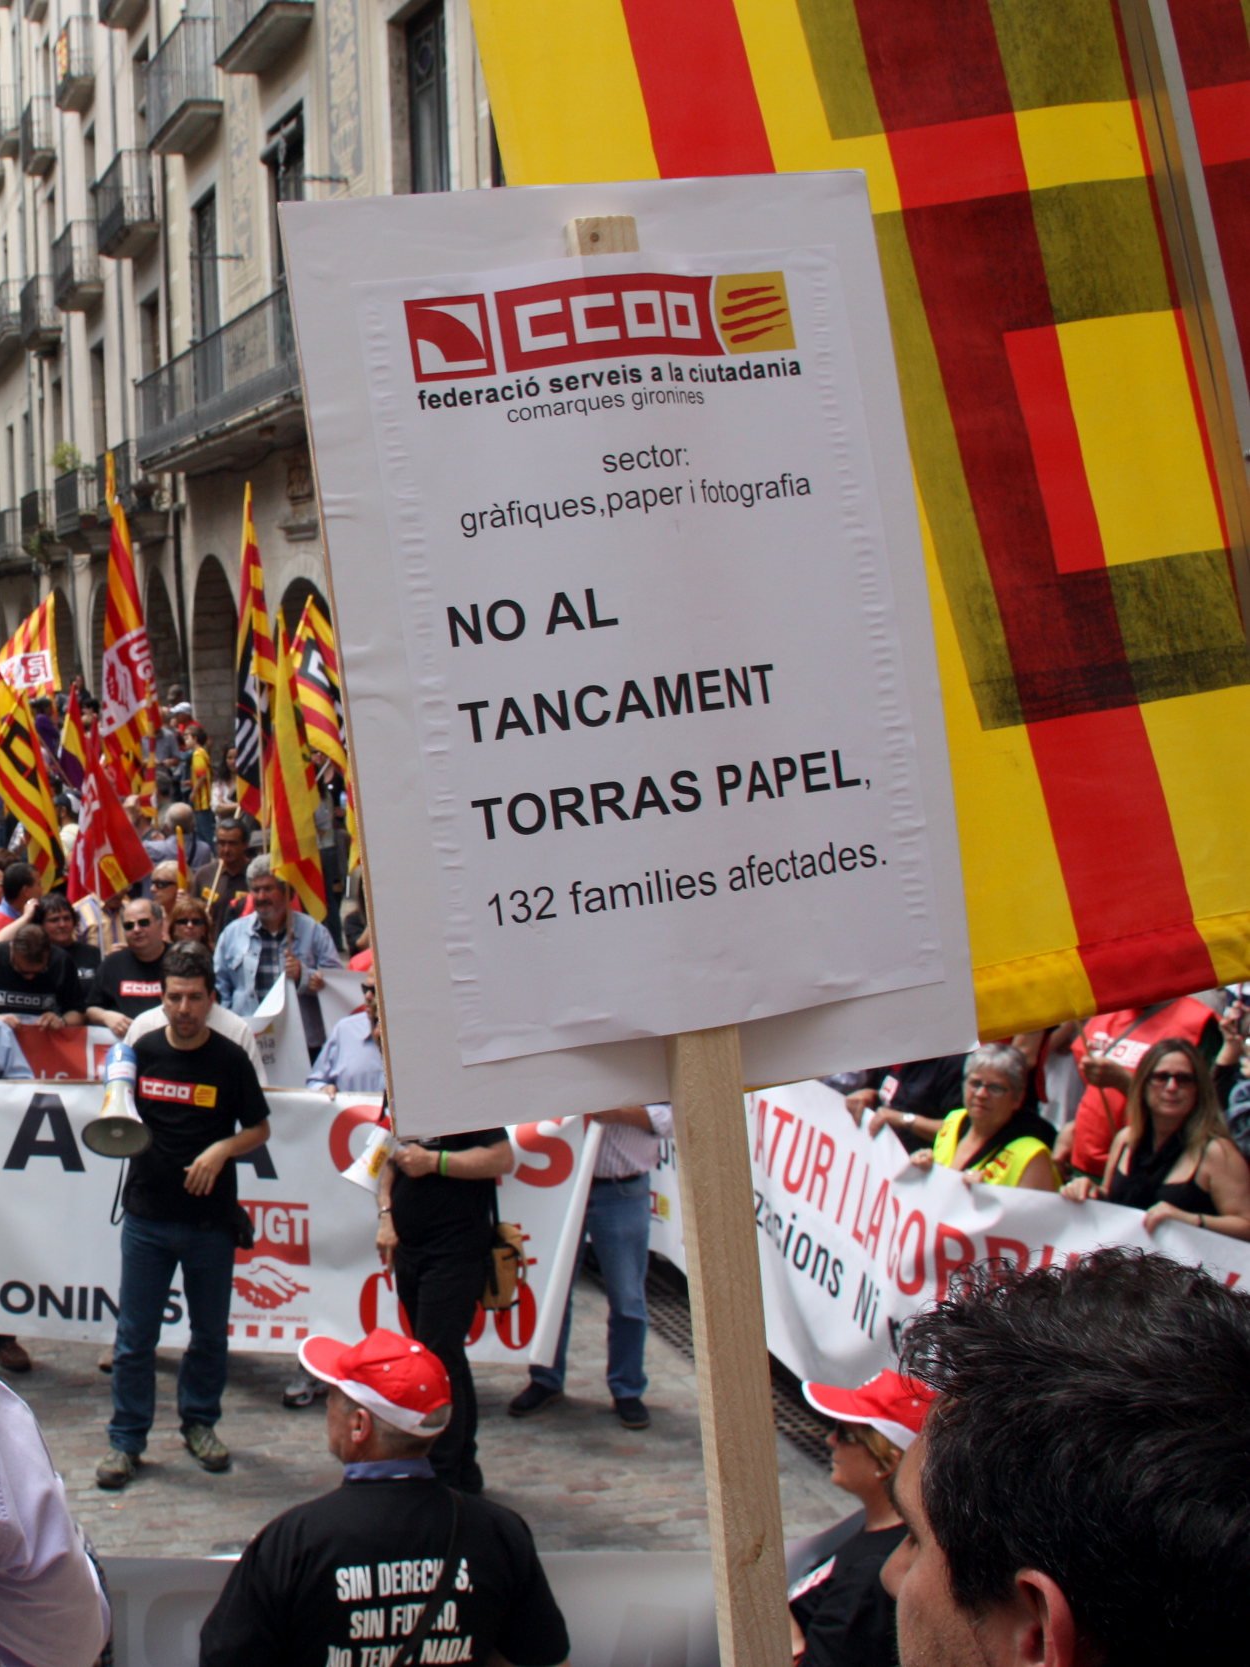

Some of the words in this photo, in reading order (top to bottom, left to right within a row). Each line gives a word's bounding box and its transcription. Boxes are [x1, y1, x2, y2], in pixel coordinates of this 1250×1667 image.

[514, 289, 701, 353] CCOO
[418, 377, 540, 411] federació
[549, 364, 643, 395] serveis
[650, 366, 663, 382] a
[668, 360, 684, 382] la
[688, 357, 802, 384] ciutadania
[507, 391, 625, 424] comarques
[631, 388, 705, 411] gironines
[601, 444, 691, 473] sector:
[689, 480, 696, 504] i
[700, 473, 812, 509] fotografia
[446, 599, 526, 648] NO
[545, 587, 619, 635] AL
[458, 663, 774, 743] TANCAMENT
[471, 769, 702, 841] TORRAS
[715, 749, 872, 807] PAPEL,
[487, 885, 557, 927] 132
[569, 863, 717, 915] families
[727, 841, 888, 892] afectades.
[141, 1079, 190, 1100] CCOO
[3, 1093, 86, 1173] A
[335, 1565, 372, 1602] SIN
[378, 1557, 474, 1597] DERECHS,
[350, 1607, 385, 1640] SIN
